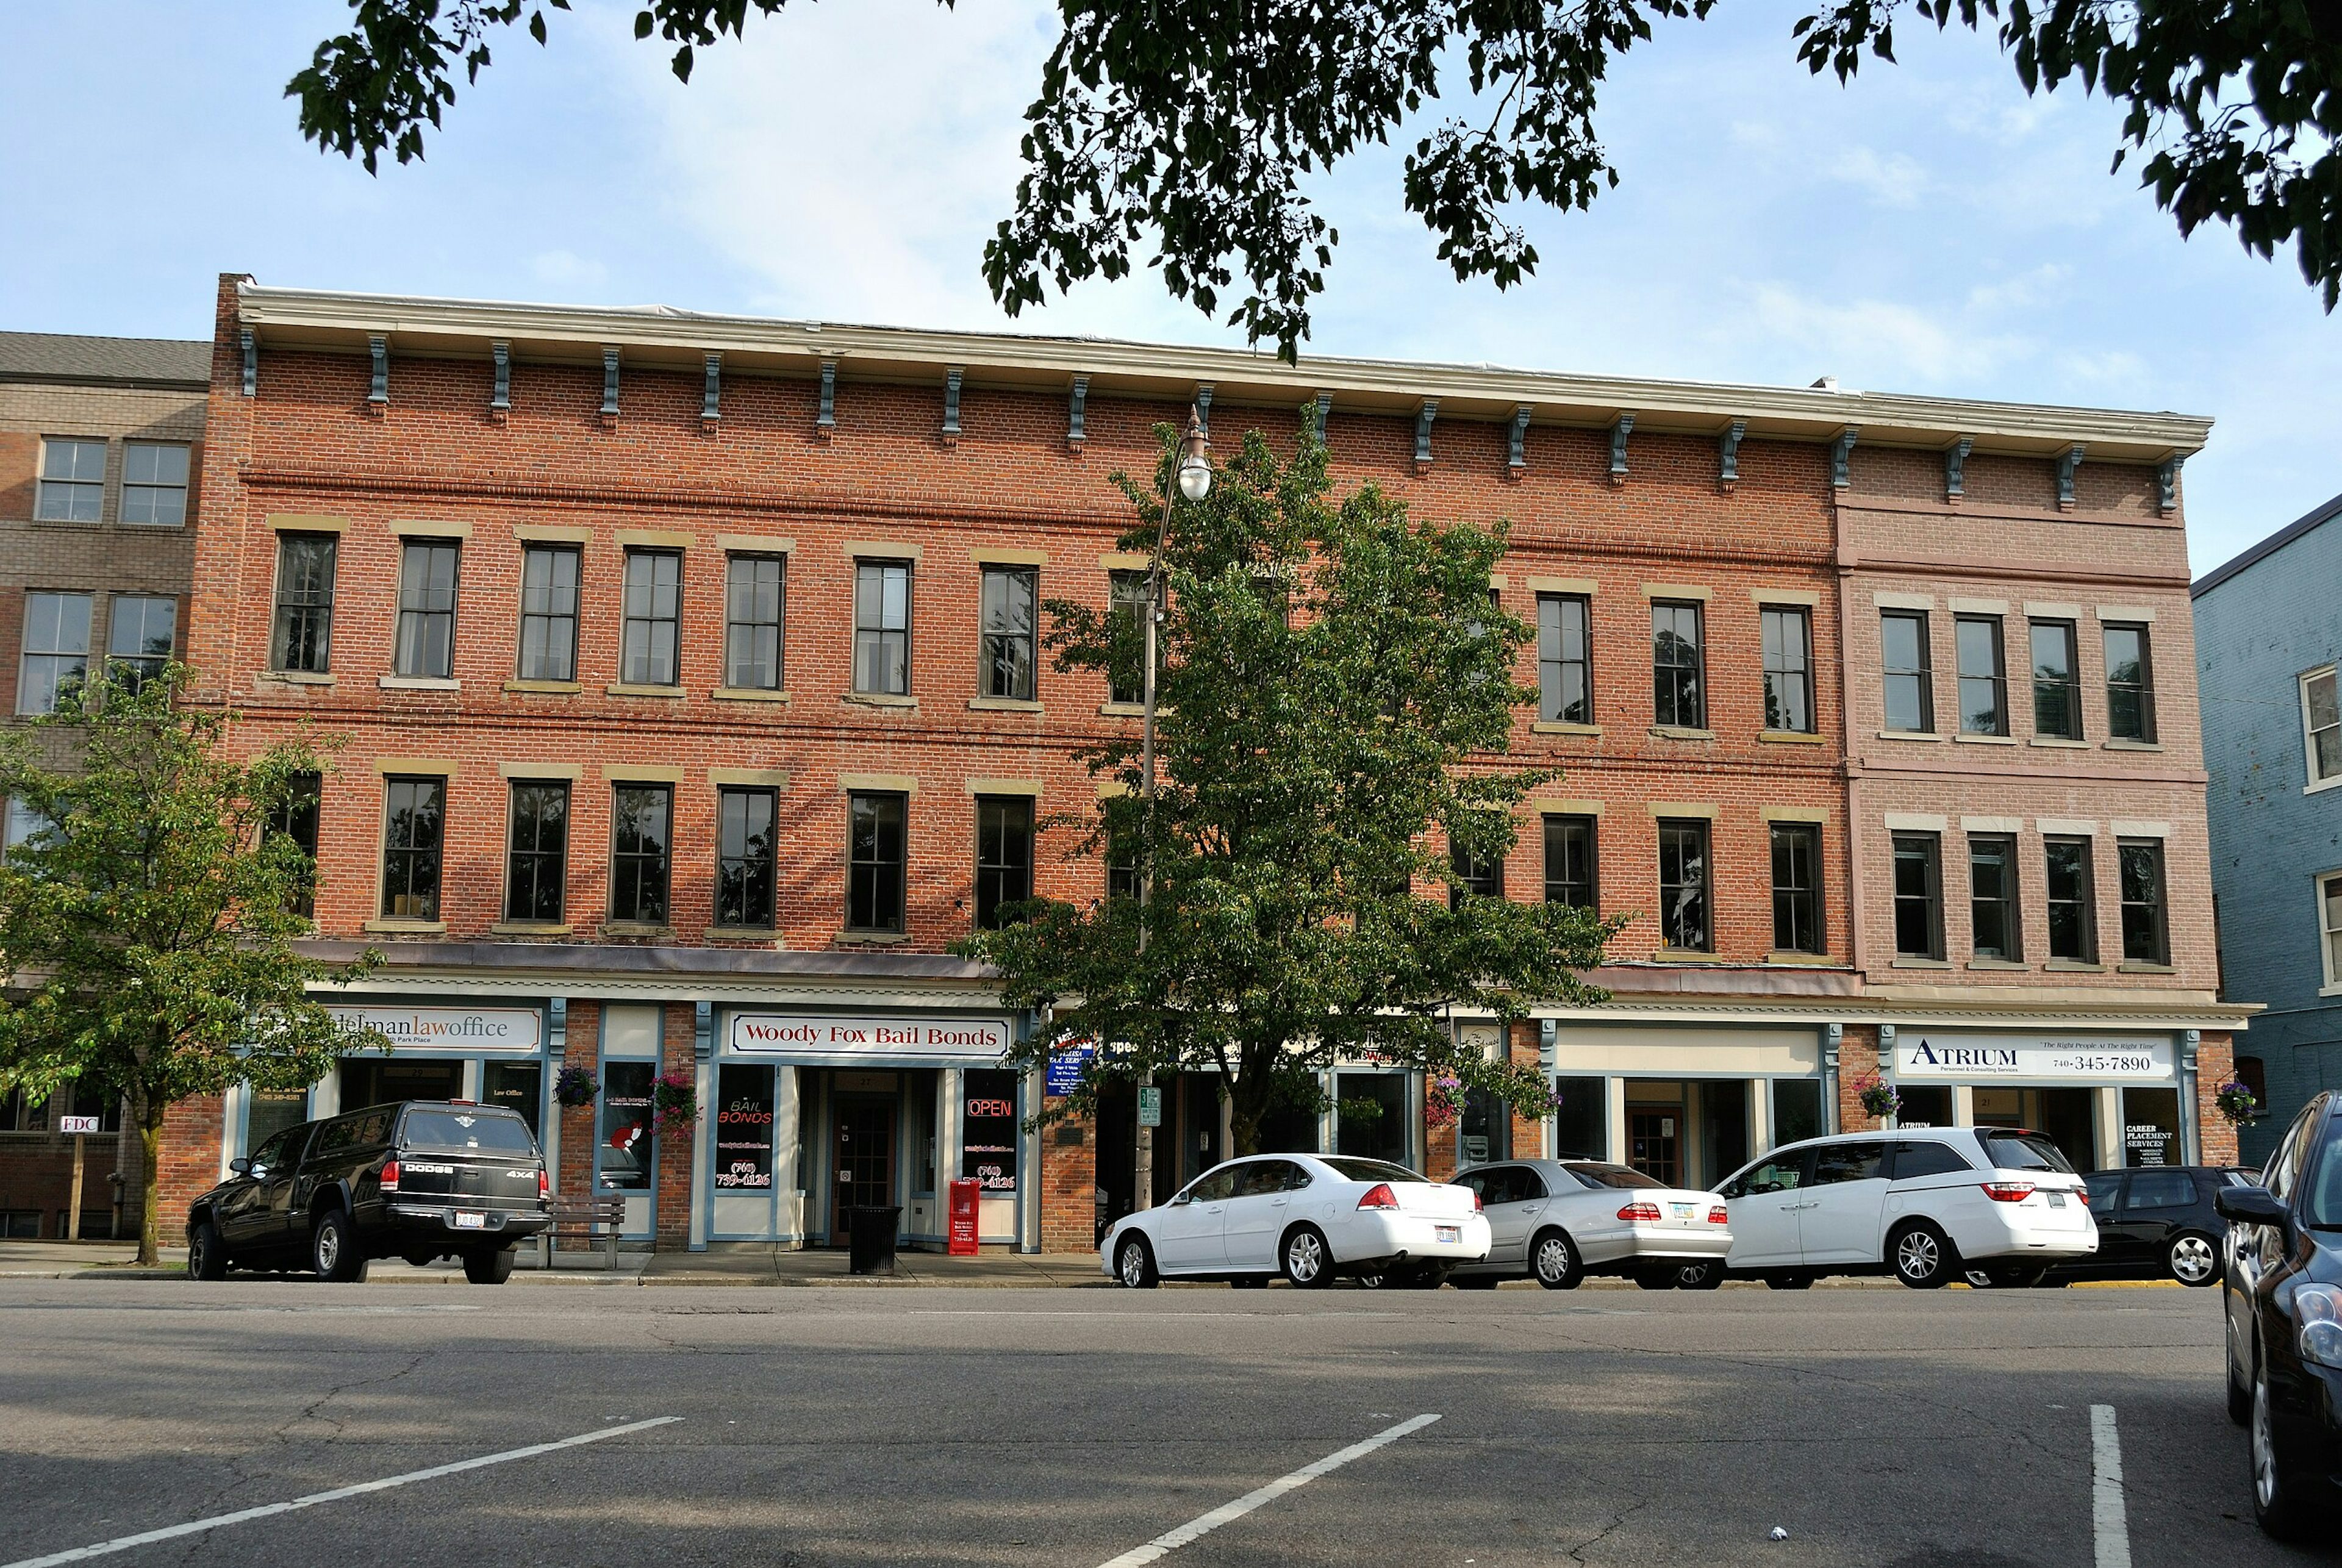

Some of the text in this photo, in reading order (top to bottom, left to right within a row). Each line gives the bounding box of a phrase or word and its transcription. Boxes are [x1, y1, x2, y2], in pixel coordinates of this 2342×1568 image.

[335, 1014, 507, 1037] delmanlawoffice
[745, 1025, 997, 1046] Woody Fox Bail Bonds
[1910, 1038, 2018, 1065] ATRIUM
[1142, 1093, 1146, 1103] 3
[731, 1101, 761, 1112] BAIL
[970, 1100, 1011, 1116] OPEN
[718, 1112, 772, 1124] BONDS
[64, 1119, 96, 1130] FDC
[405, 1164, 454, 1174] DODGE
[716, 1173, 770, 1186] 739-4126
